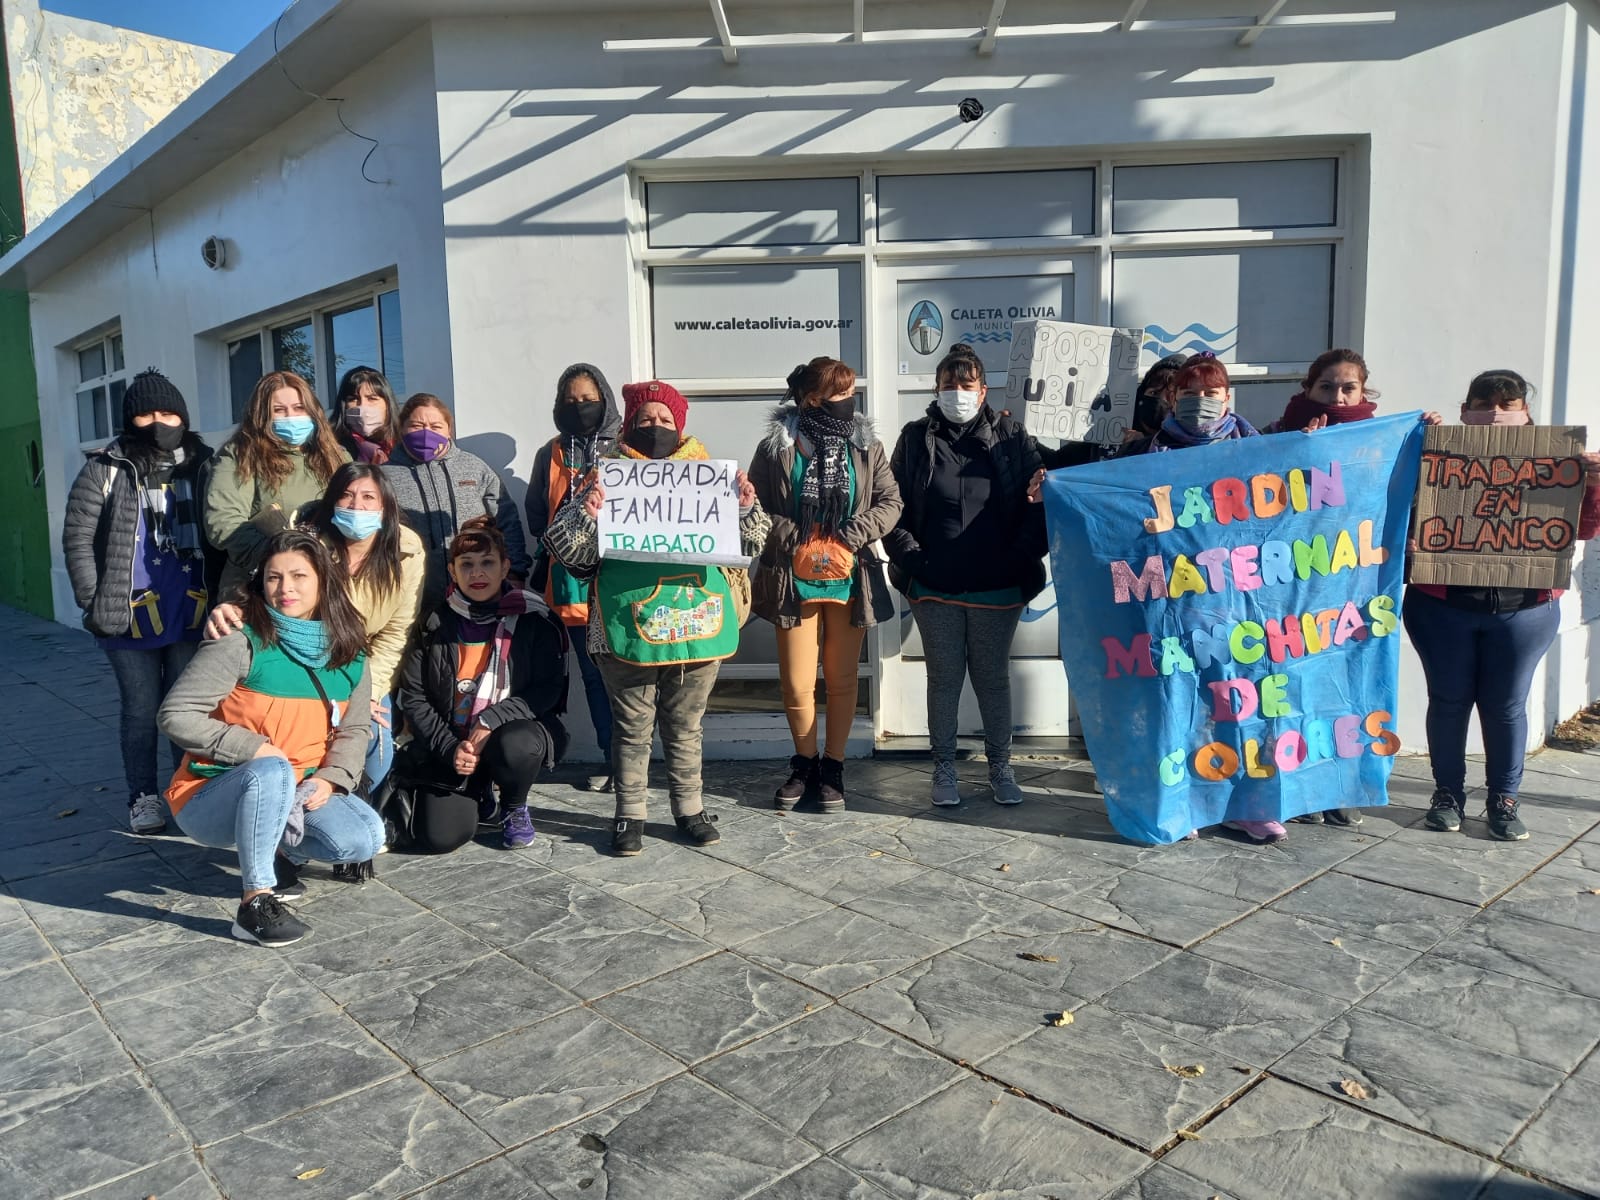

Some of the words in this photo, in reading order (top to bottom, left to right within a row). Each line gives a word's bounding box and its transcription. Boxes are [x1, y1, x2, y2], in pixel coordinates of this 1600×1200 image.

[674, 316, 854, 332] www.caletaolivia.gov.ar
[951, 308, 1003, 320] CALETA
[1007, 306, 1056, 318] OLIVIA
[974, 321, 1012, 331] MUNICI
[1010, 325, 1139, 370] APORTE
[1422, 450, 1584, 490] TRABAJO
[1143, 460, 1346, 535] JARDIN
[1473, 487, 1523, 518] EN
[605, 533, 716, 554] TRABAJO
[1418, 515, 1574, 553] BLANCO
[1110, 519, 1390, 604] MATERNAL
[1101, 594, 1399, 680] MANCHITAS
[1207, 673, 1292, 722] DE
[1159, 710, 1402, 787] COLORES
